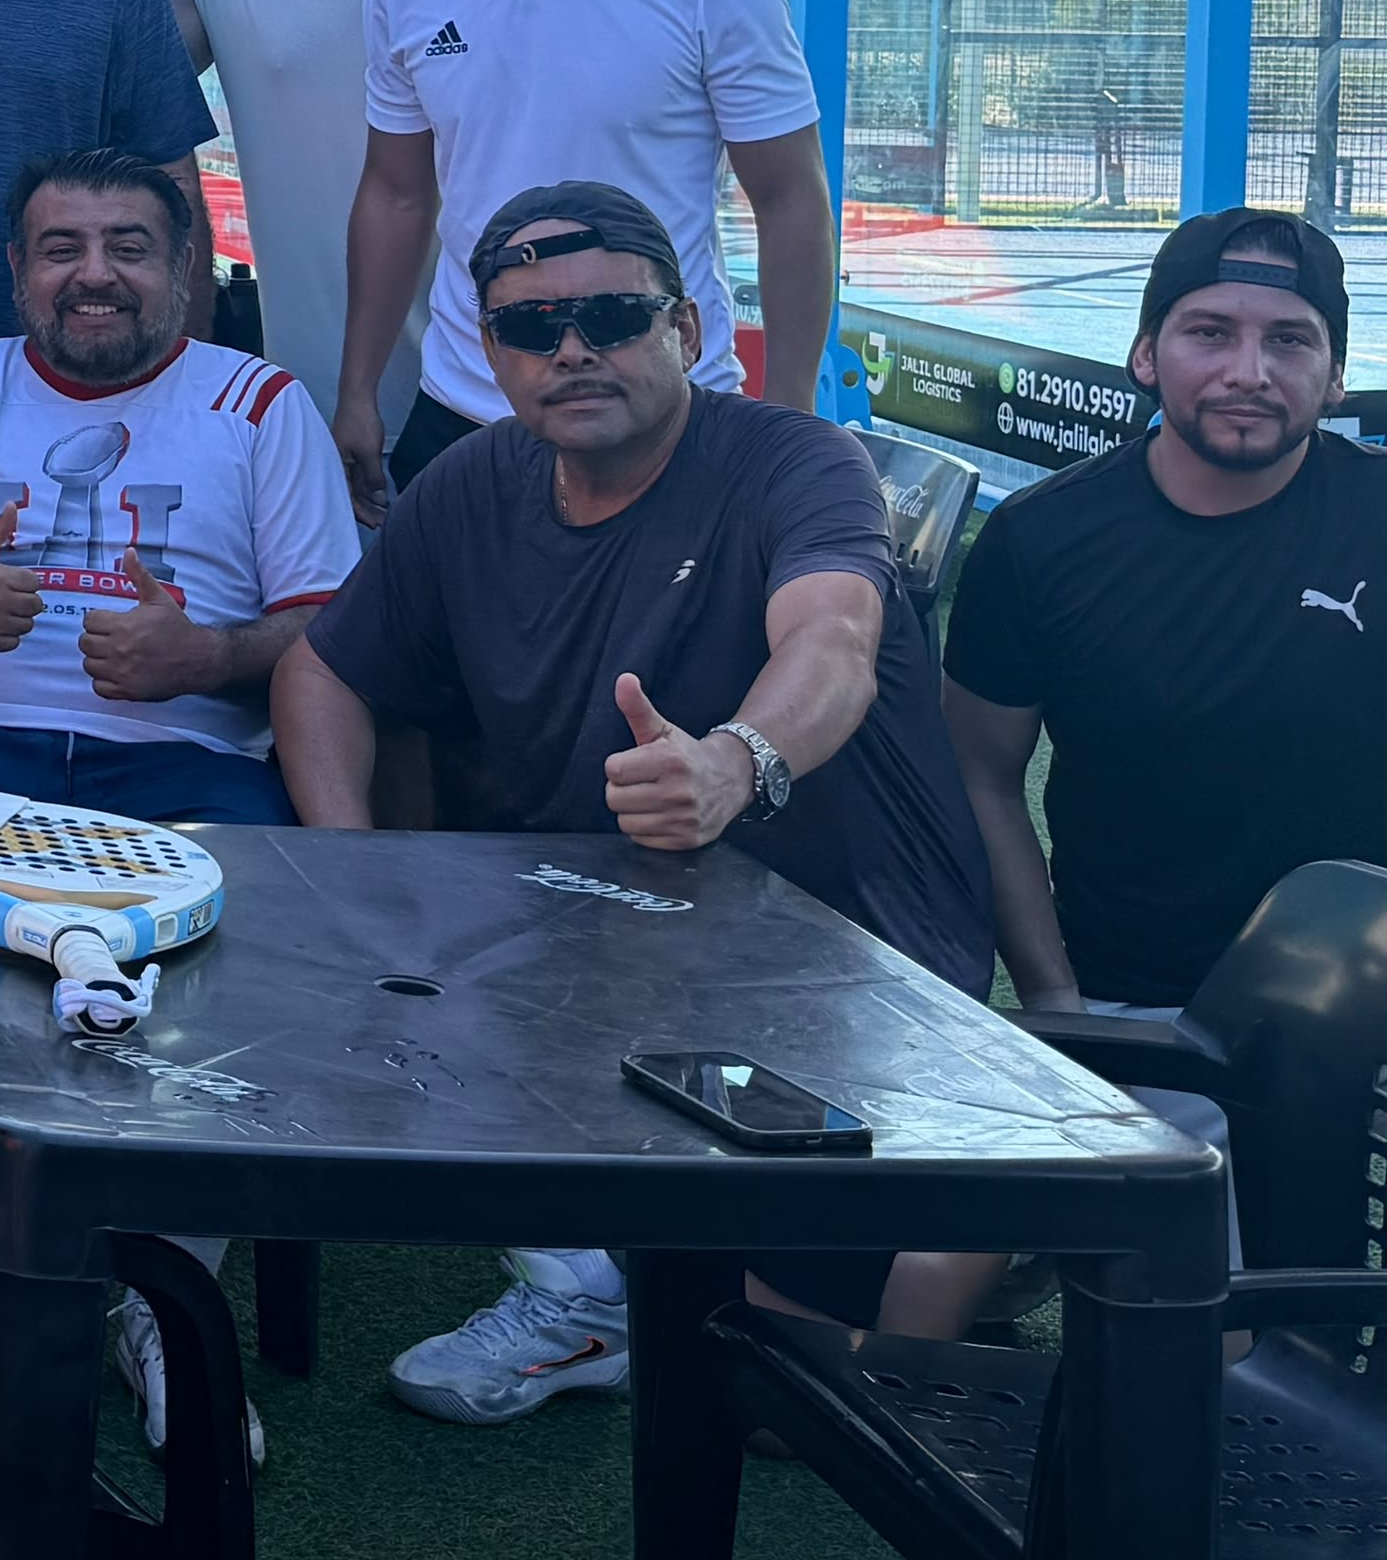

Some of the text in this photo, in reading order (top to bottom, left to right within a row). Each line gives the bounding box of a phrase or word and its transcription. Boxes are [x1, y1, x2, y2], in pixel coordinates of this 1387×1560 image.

[426, 42, 468, 57] adidas
[901, 355, 975, 389] JALIL GLOBAL
[912, 377, 962, 403] LOGISTICS
[1016, 368, 1136, 424] 81.2910.9597
[79, 574, 137, 592] BOW
